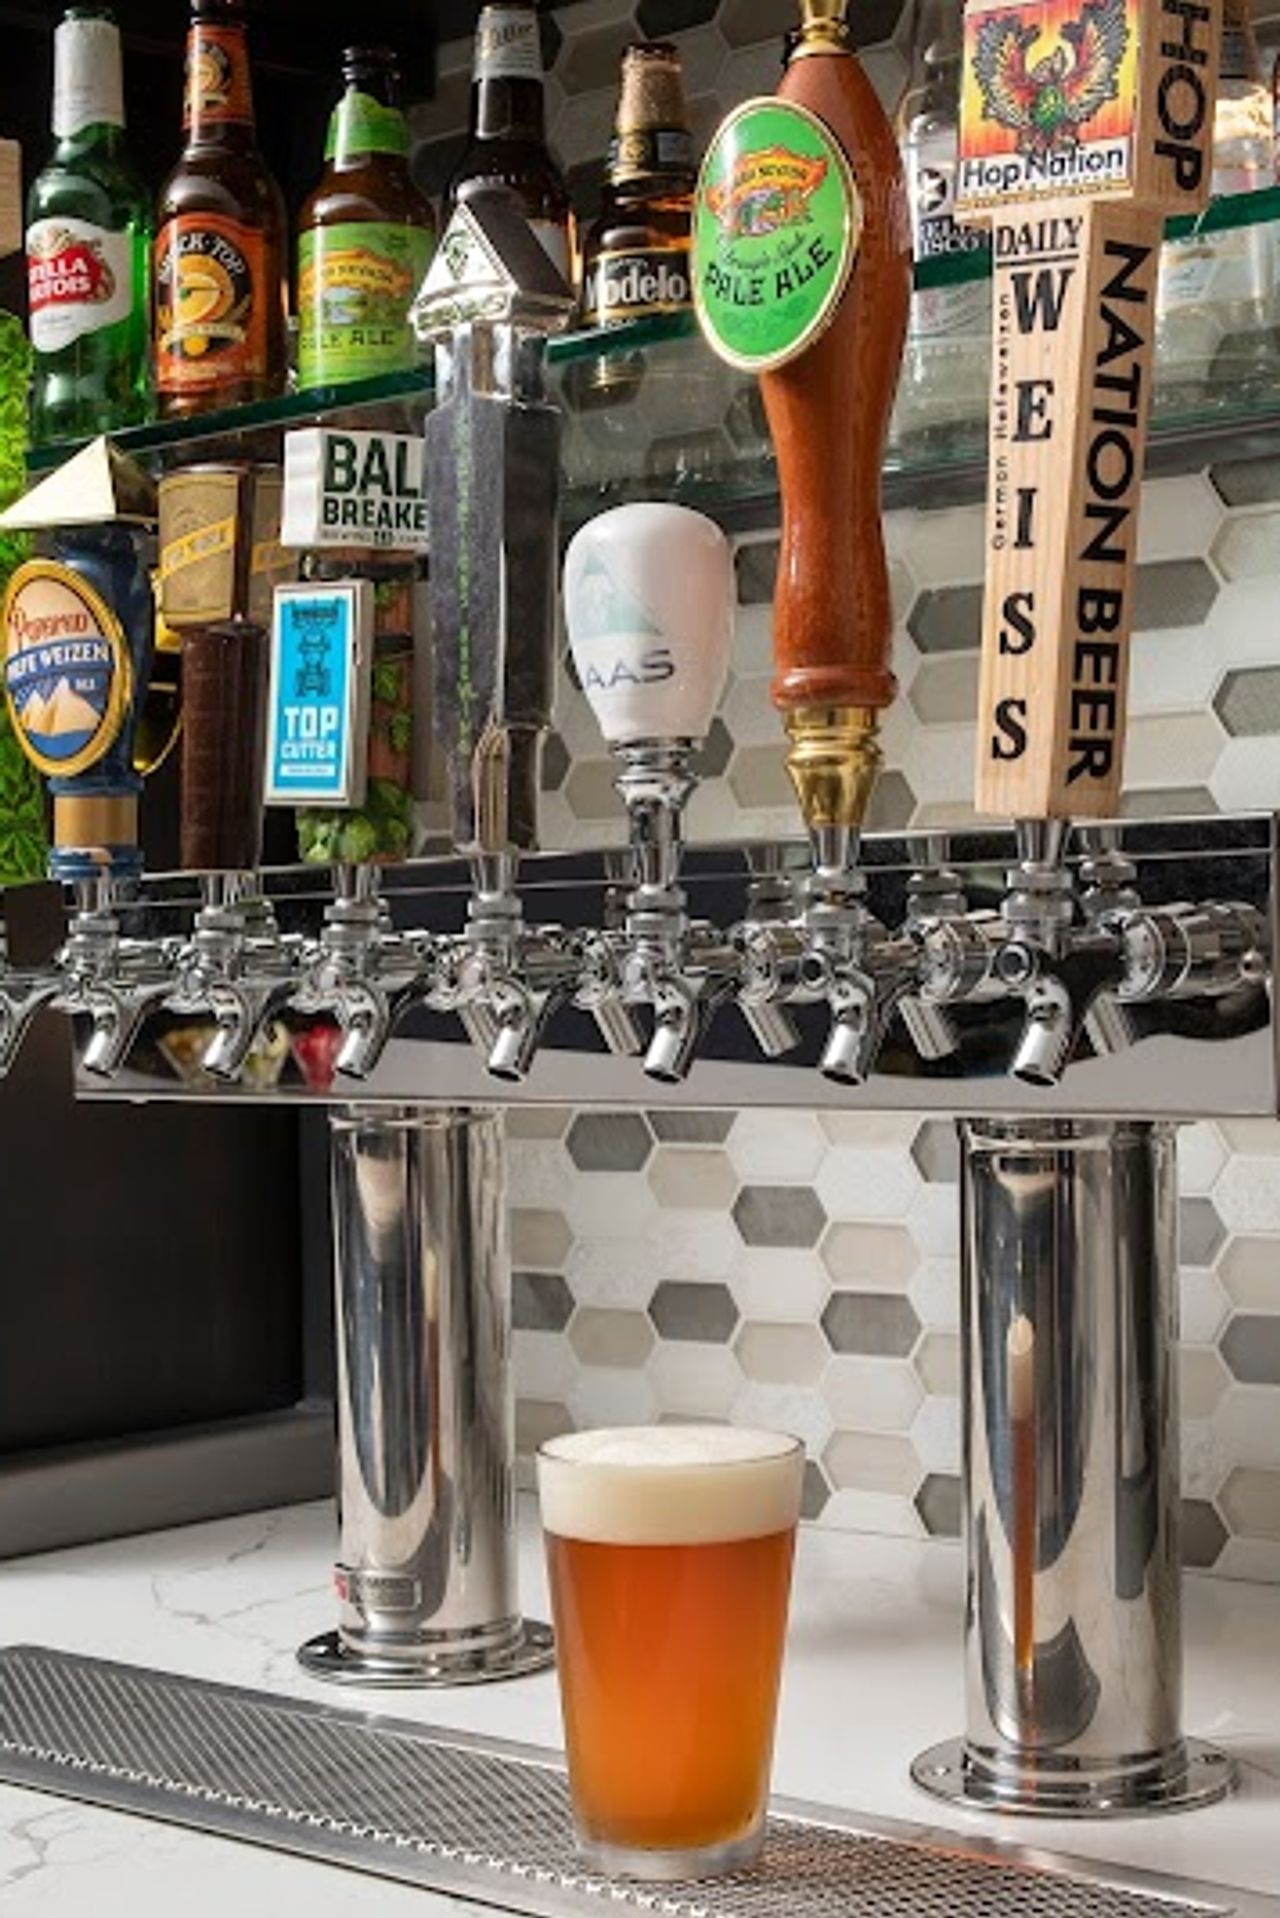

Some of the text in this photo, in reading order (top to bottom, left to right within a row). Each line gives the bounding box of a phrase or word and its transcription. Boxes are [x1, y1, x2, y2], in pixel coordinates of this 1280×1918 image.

[996, 215, 1084, 257] DAILY
[586, 264, 687, 309] Modelo
[704, 261, 765, 306] PALE
[775, 236, 833, 299] ALE
[1066, 0, 1210, 787] HOP NATION BEER
[323, 434, 420, 498] BAL
[323, 496, 427, 531] BREAKE
[284, 706, 338, 738] TOP
